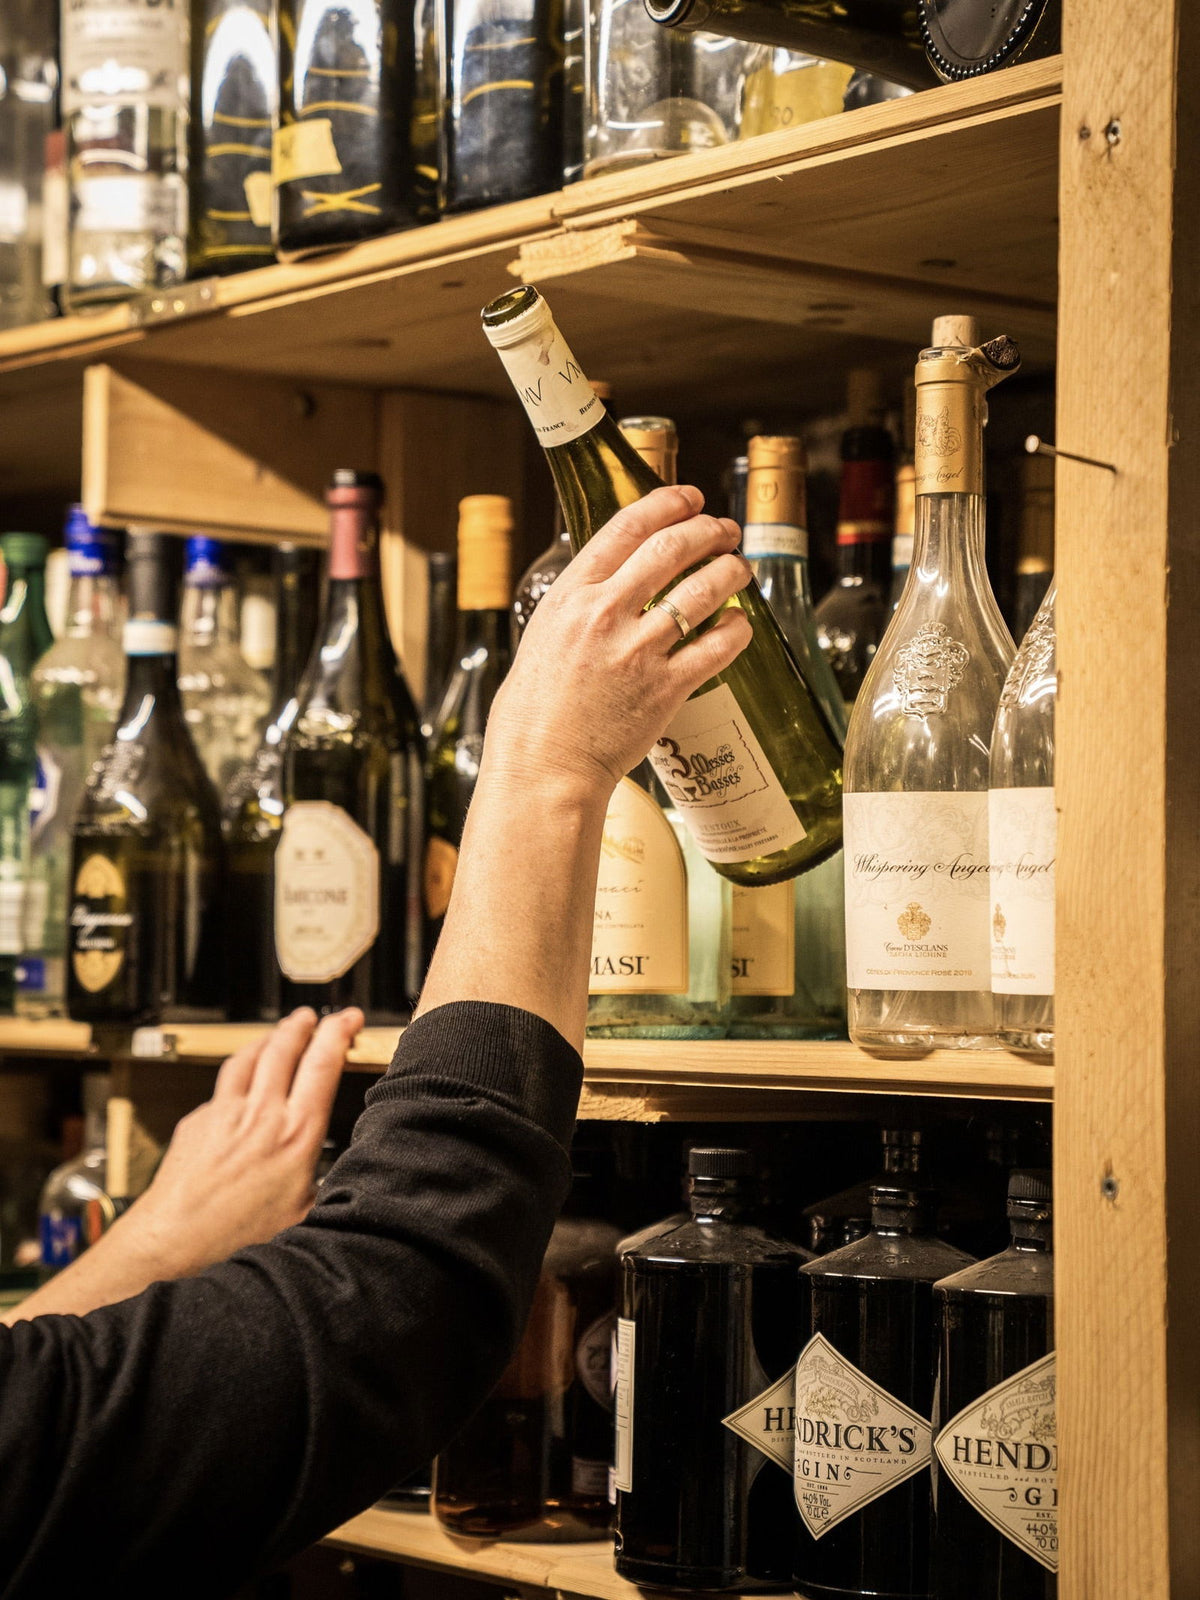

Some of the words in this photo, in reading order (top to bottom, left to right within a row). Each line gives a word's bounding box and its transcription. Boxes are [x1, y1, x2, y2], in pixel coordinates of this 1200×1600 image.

[656, 737, 691, 778] 3
[689, 744, 735, 778] Messes
[688, 765, 744, 798] Basses
[852, 853, 931, 881] Whispering
[802, 1459, 840, 1481] GIN
[854, 1456, 907, 1465] SCOTLAND
[959, 1469, 1009, 1480] DISTILLED
[1035, 1537, 1047, 1549] 70
